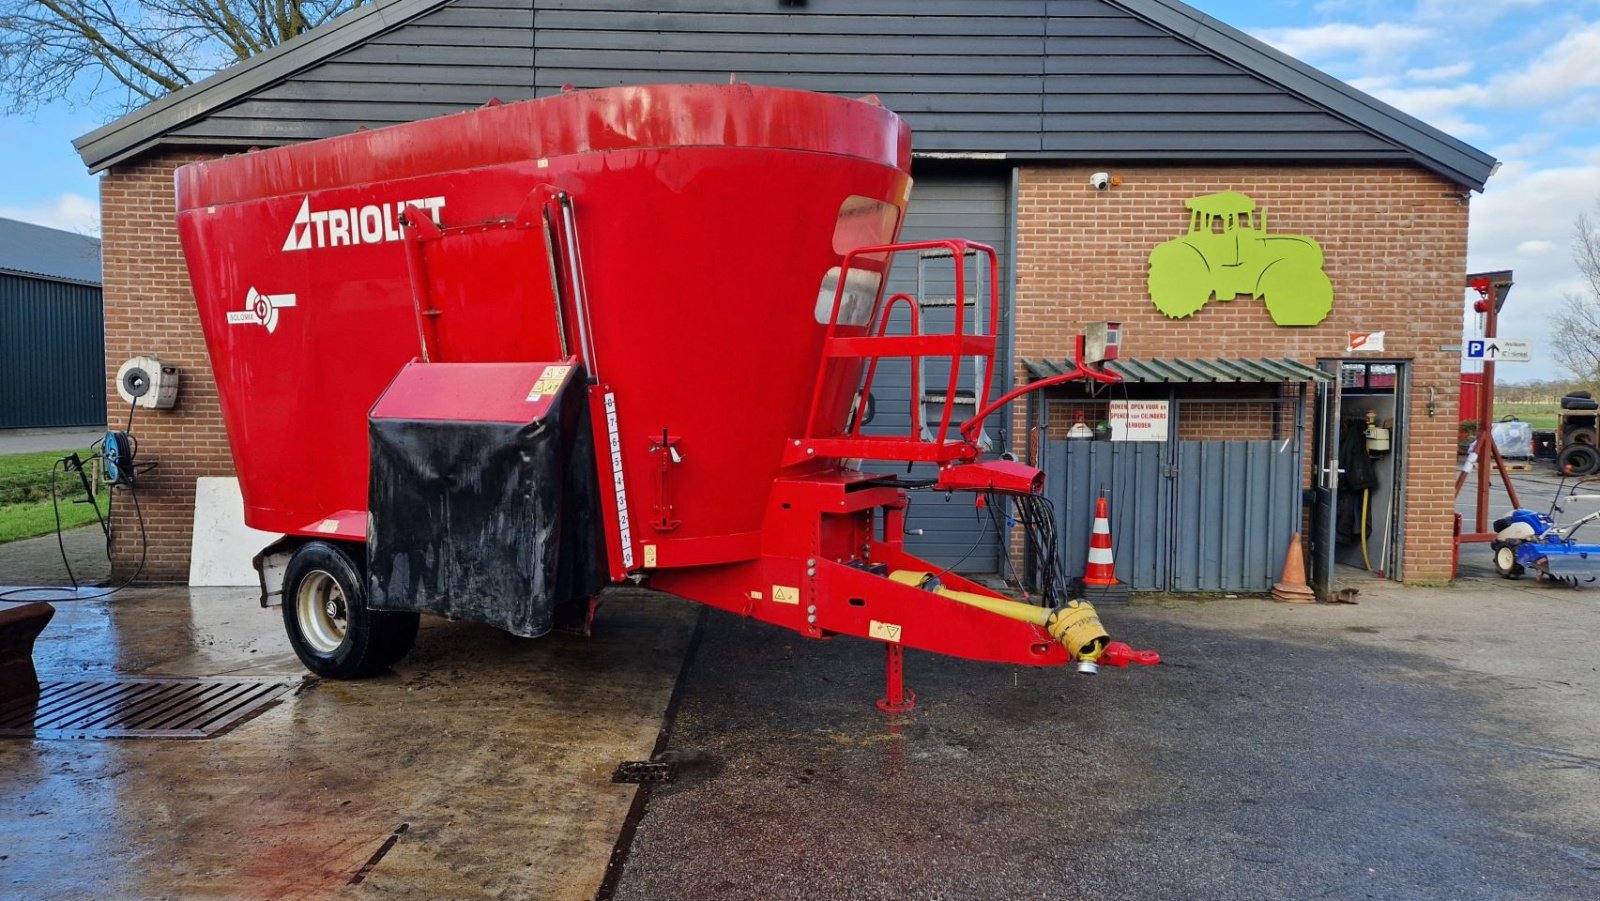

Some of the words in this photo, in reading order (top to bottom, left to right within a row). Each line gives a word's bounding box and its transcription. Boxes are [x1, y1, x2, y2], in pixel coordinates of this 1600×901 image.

[1470, 343, 1481, 355] P
[609, 418, 615, 427] 7
[612, 438, 618, 447] 6
[614, 457, 620, 466] 5
[619, 496, 624, 505] 3
[621, 515, 627, 525] 2
[625, 553, 631, 562] 0
